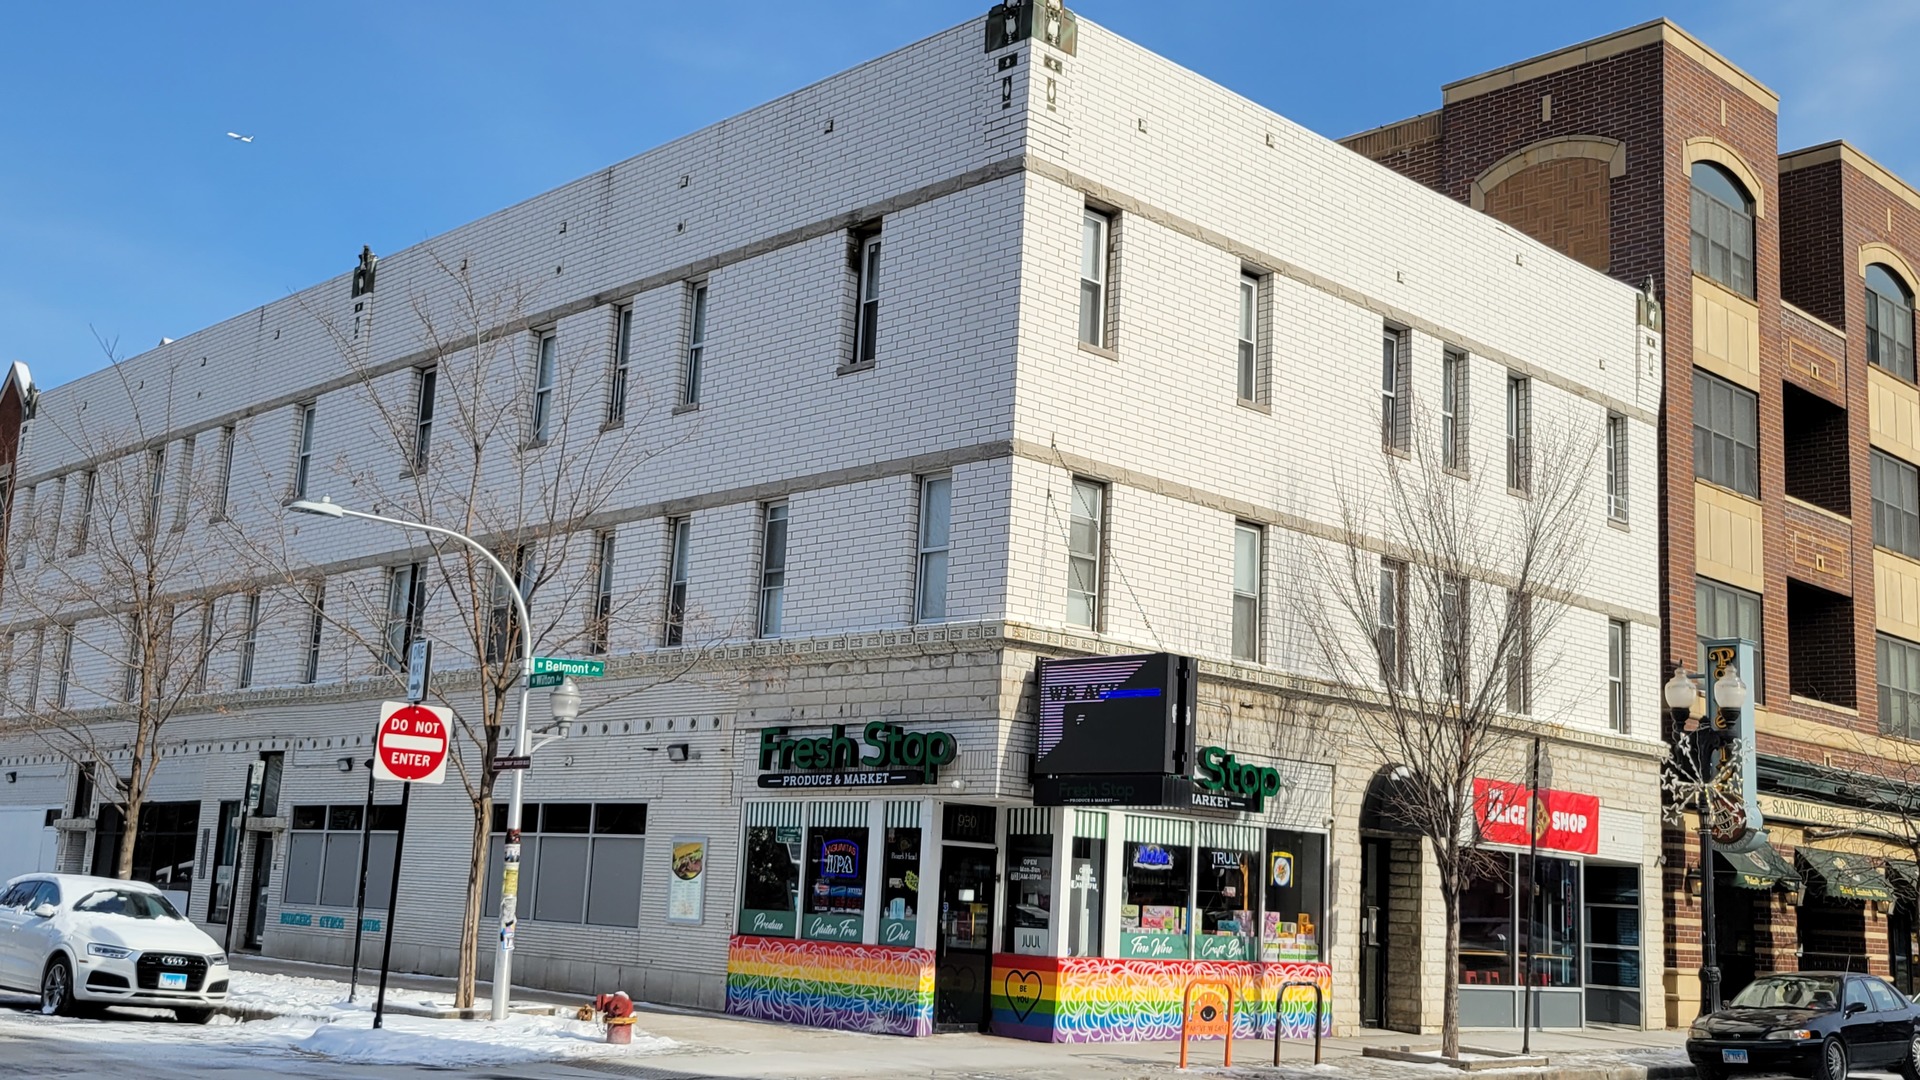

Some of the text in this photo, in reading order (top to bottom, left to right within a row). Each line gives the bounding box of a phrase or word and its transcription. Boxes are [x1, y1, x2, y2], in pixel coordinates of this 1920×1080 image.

[545, 660, 589, 674] Belmont
[536, 674, 555, 685] Wilton
[390, 718, 440, 734] DO NOT
[390, 752, 431, 767] ENTER
[759, 720, 955, 785] Fresh Stop
[782, 772, 889, 786] PRODUCE & MARKET
[1200, 746, 1281, 813] Stop
[1487, 802, 1588, 834] SLICE SHOP
[1772, 799, 1835, 822] SANDWICHES
[957, 814, 977, 828] 930
[825, 854, 854, 874] IPA
[1211, 851, 1243, 865] TRULY
[753, 911, 784, 931] Produce
[809, 916, 858, 938] Gluten Free
[885, 922, 911, 943] Deli
[1021, 934, 1041, 949] JUUL
[1130, 935, 1174, 958] Fine Wine
[1201, 937, 1227, 958] Craft
[1019, 984, 1028, 993] BE
[1016, 995, 1030, 1004] YOU
